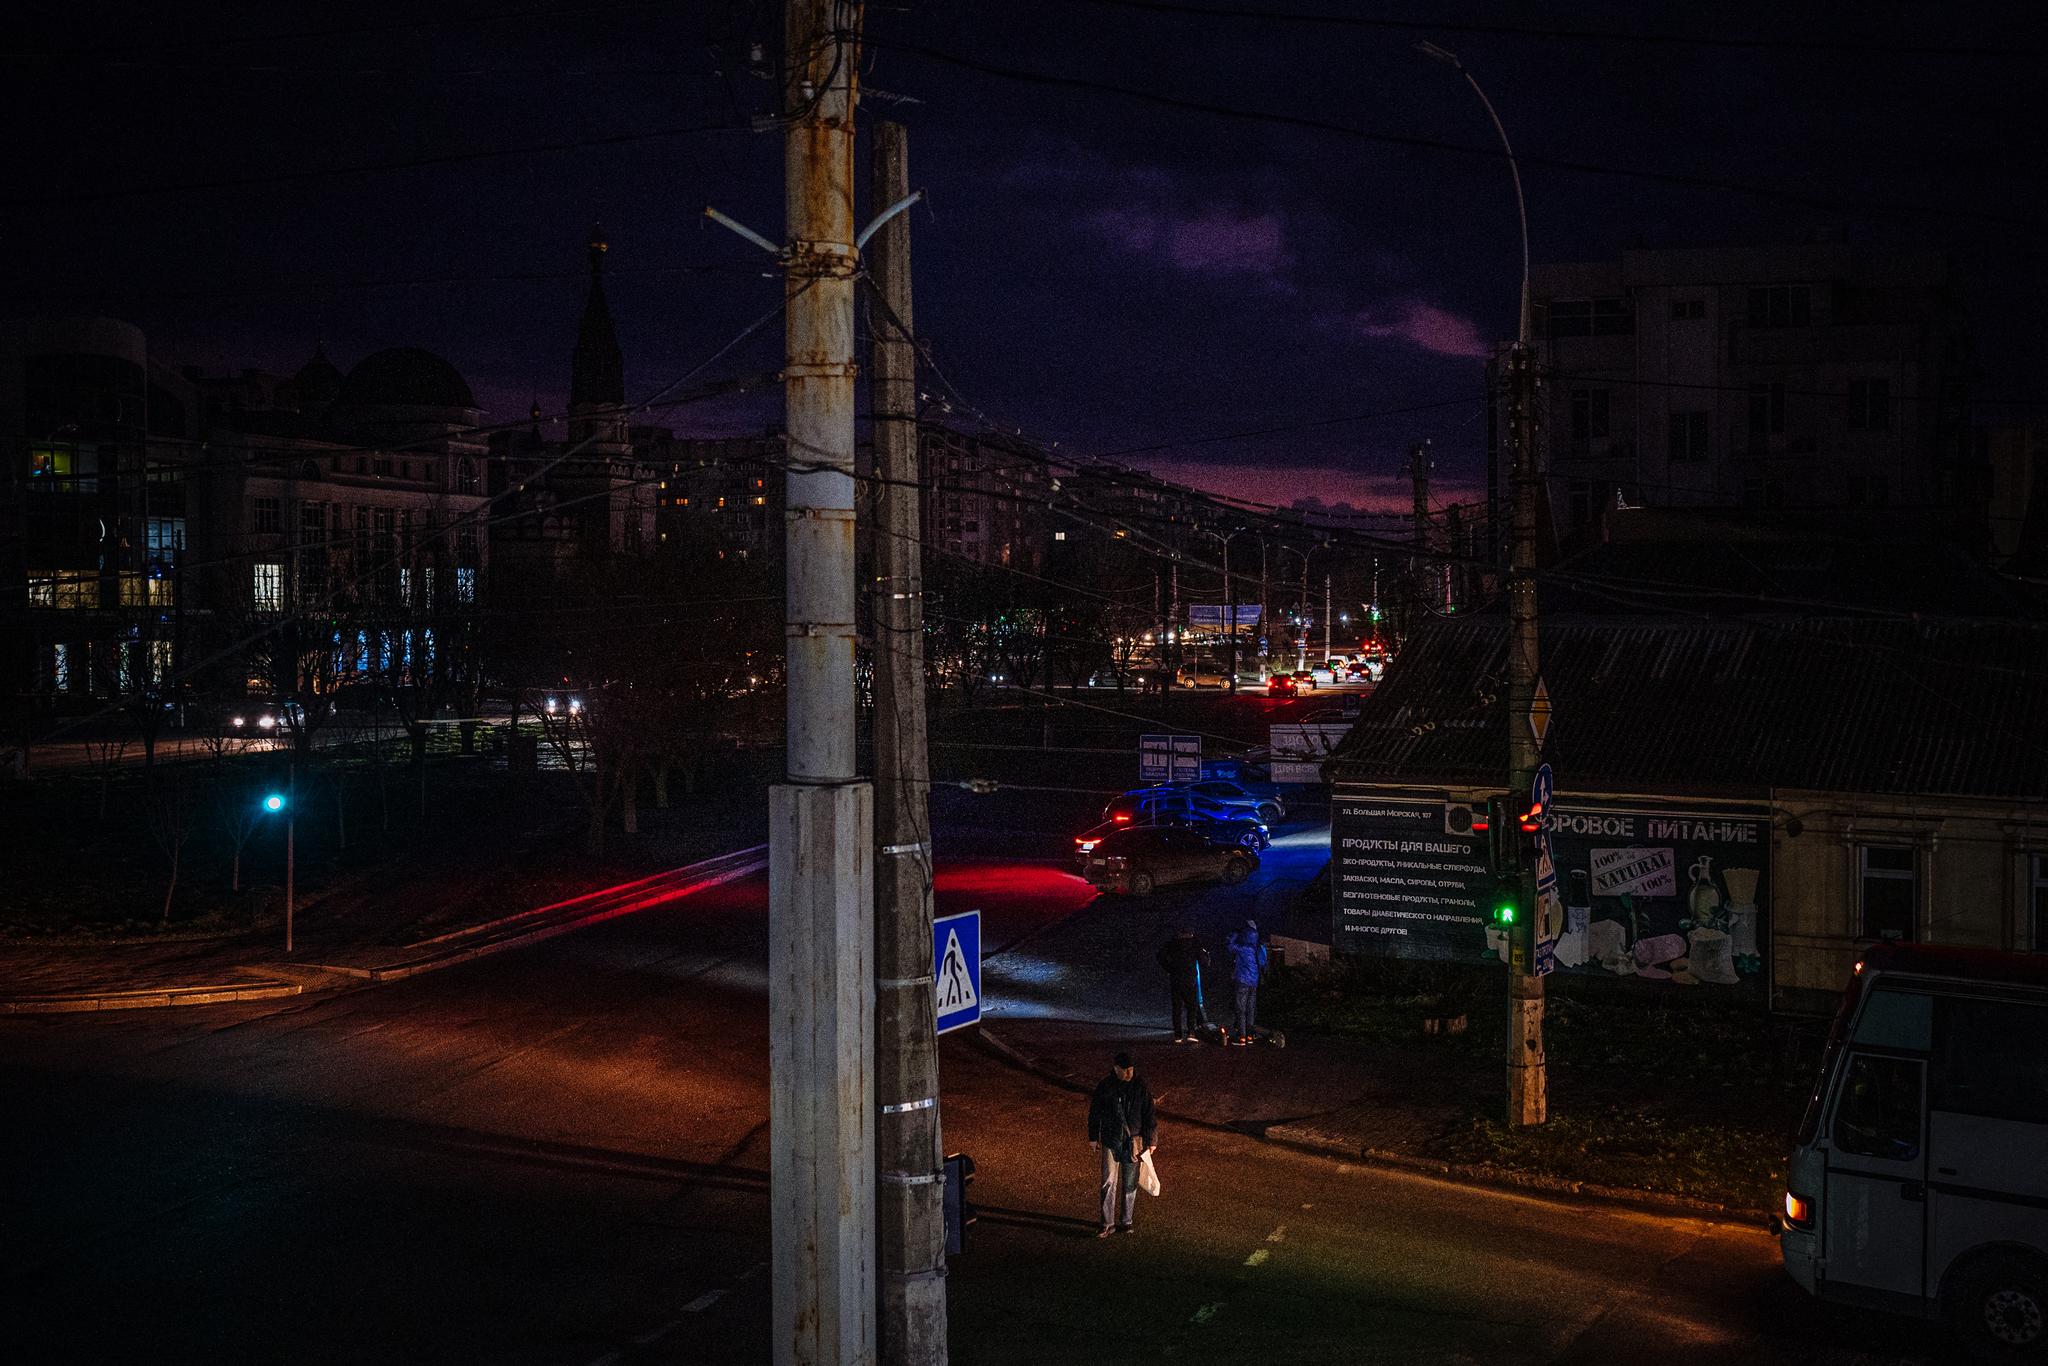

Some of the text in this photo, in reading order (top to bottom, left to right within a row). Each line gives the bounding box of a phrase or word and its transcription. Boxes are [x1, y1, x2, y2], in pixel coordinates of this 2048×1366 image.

[1647, 818, 1759, 843] ПИТАНИЕ
[1342, 838, 1471, 855] ПРОДУКТЫ ДЛЯ ВАШЕГО
[1342, 857, 1487, 874] ЭКО-ПРОДУКТЫ, УНИКАЛЬНЫЕ СУПЕРФУДЫ,
[1598, 852, 1671, 890] NATURAL
[1342, 874, 1466, 890] ЗАКВАСКИ, МАСЛА, СИРОПЫ, ОТРУБИ,
[1641, 873, 1672, 892] 100%
[1401, 895, 1439, 904] ПРОДУКТЫ,
[1440, 898, 1476, 908] ГРАНОЛЫ,
[1343, 908, 1484, 925] ТОВАРЫ ДИАБЕТИЧЕСКОГО НАПРАВЛЕНИЯ,
[1351, 925, 1380, 934] МНОГОЕ
